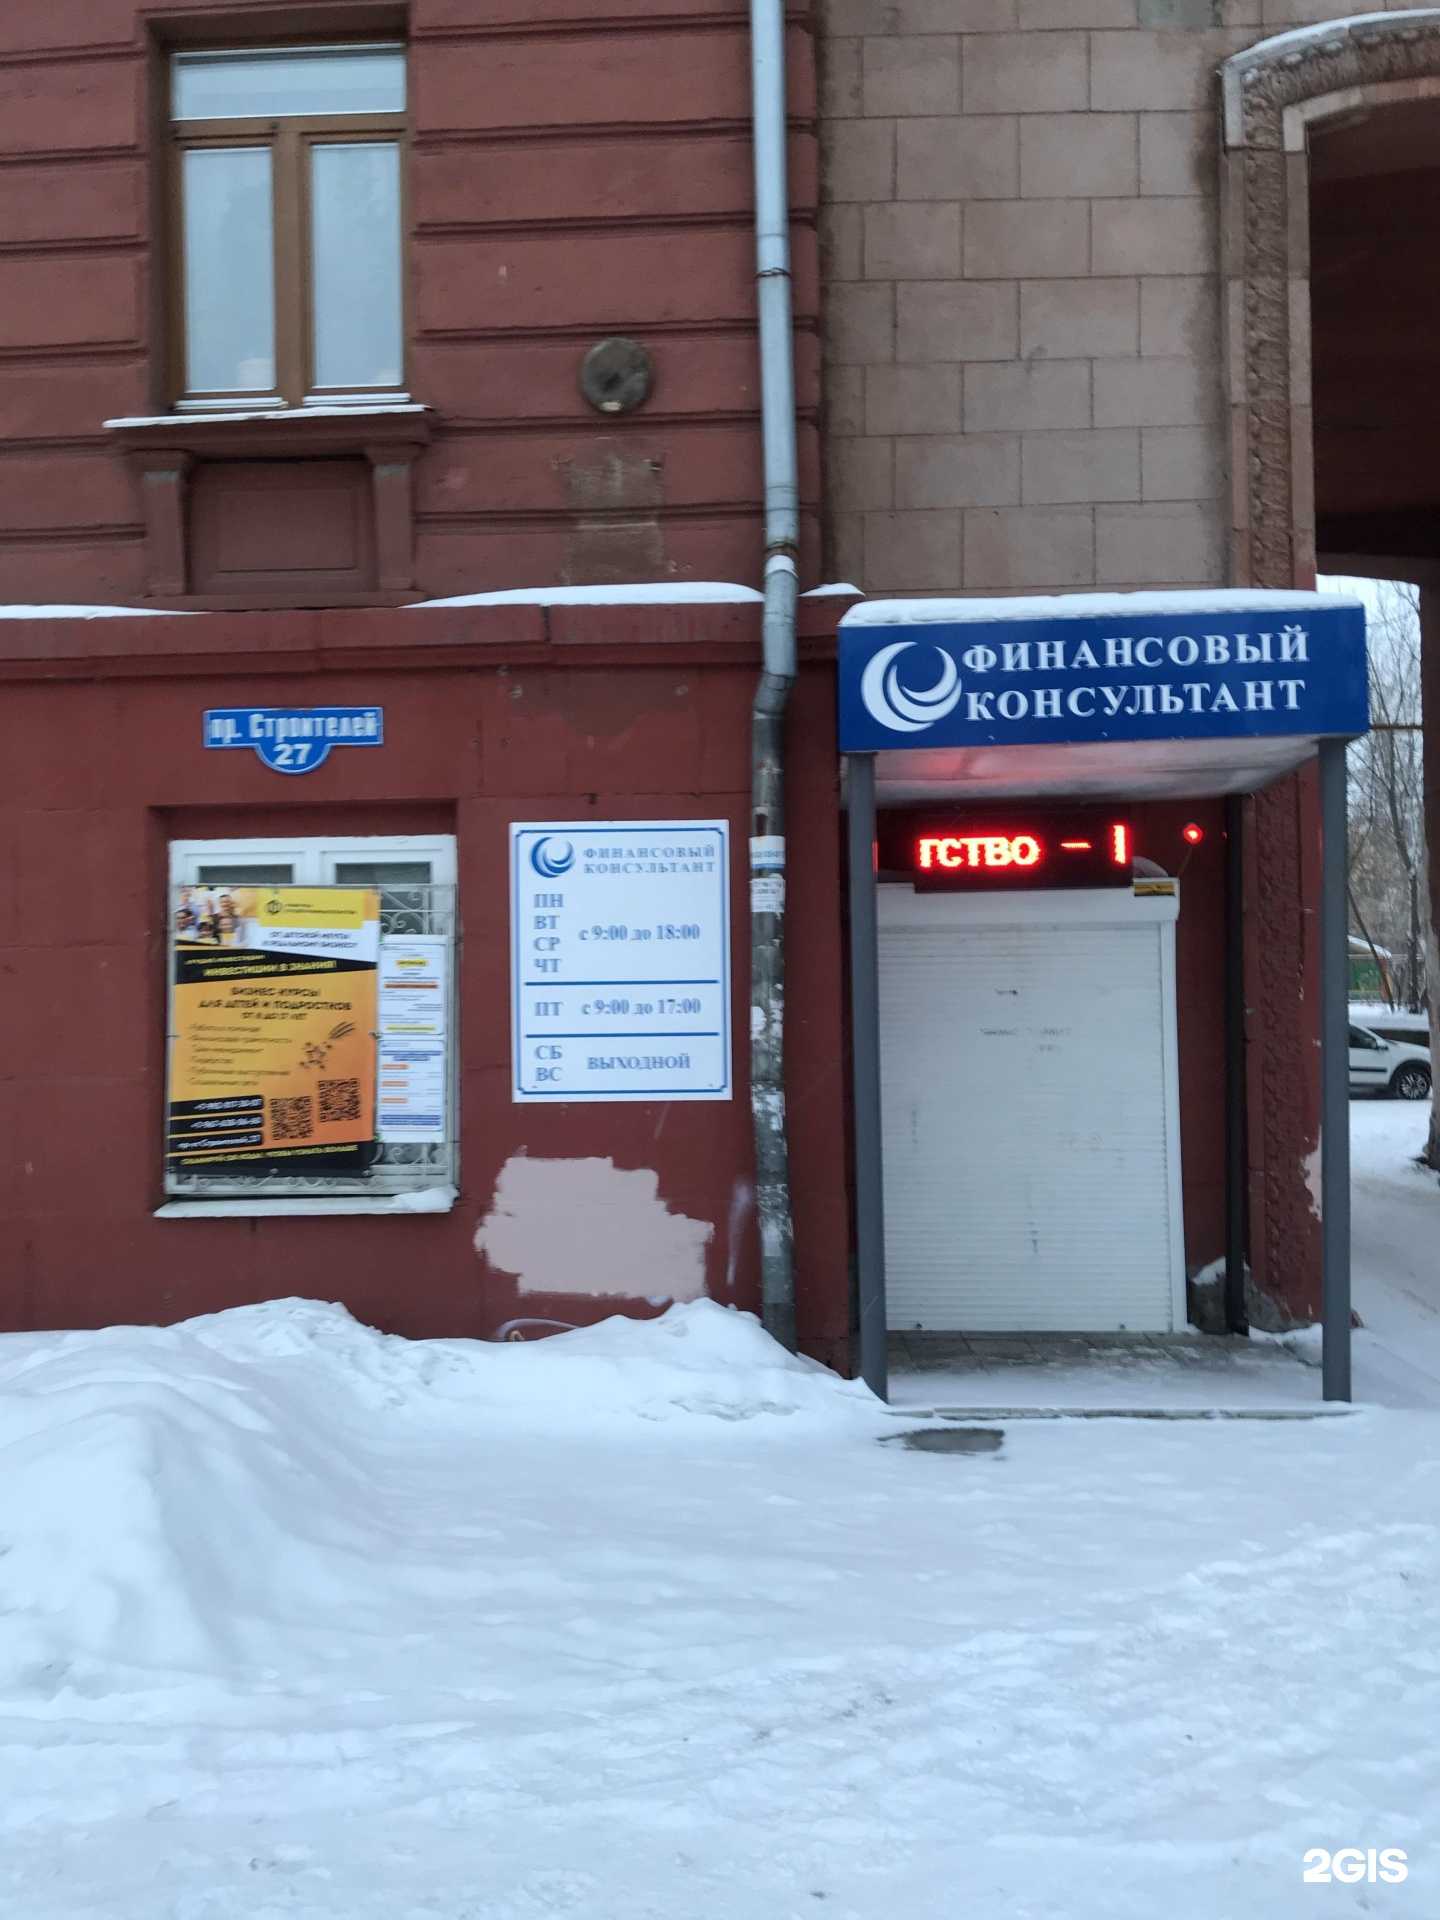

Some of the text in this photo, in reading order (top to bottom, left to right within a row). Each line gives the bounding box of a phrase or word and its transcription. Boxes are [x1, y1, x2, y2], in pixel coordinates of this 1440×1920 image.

[962, 624, 1310, 673] ФИНАНСОВЫЙ
[964, 680, 1305, 721] КОНСУЛЬТАНТ
[249, 711, 377, 743] Строителей
[273, 743, 312, 765] 27
[583, 844, 715, 859] ФИНАНСОВЫЙ
[583, 861, 715, 874] КОНСУЛЬТАНТ
[533, 893, 564, 908] ПН
[533, 915, 560, 930] ВТ
[591, 925, 628, 941] 9:00
[630, 928, 651, 941] до
[656, 923, 700, 940] 18:00
[533, 936, 560, 951] СР
[534, 958, 561, 973] ЧТ
[534, 1001, 563, 1017] ПТ
[594, 999, 630, 1015] 9:00
[632, 1002, 653, 1016] до
[657, 998, 701, 1014] 17:00
[534, 1045, 563, 1060] СБ
[535, 1067, 562, 1081] ВС
